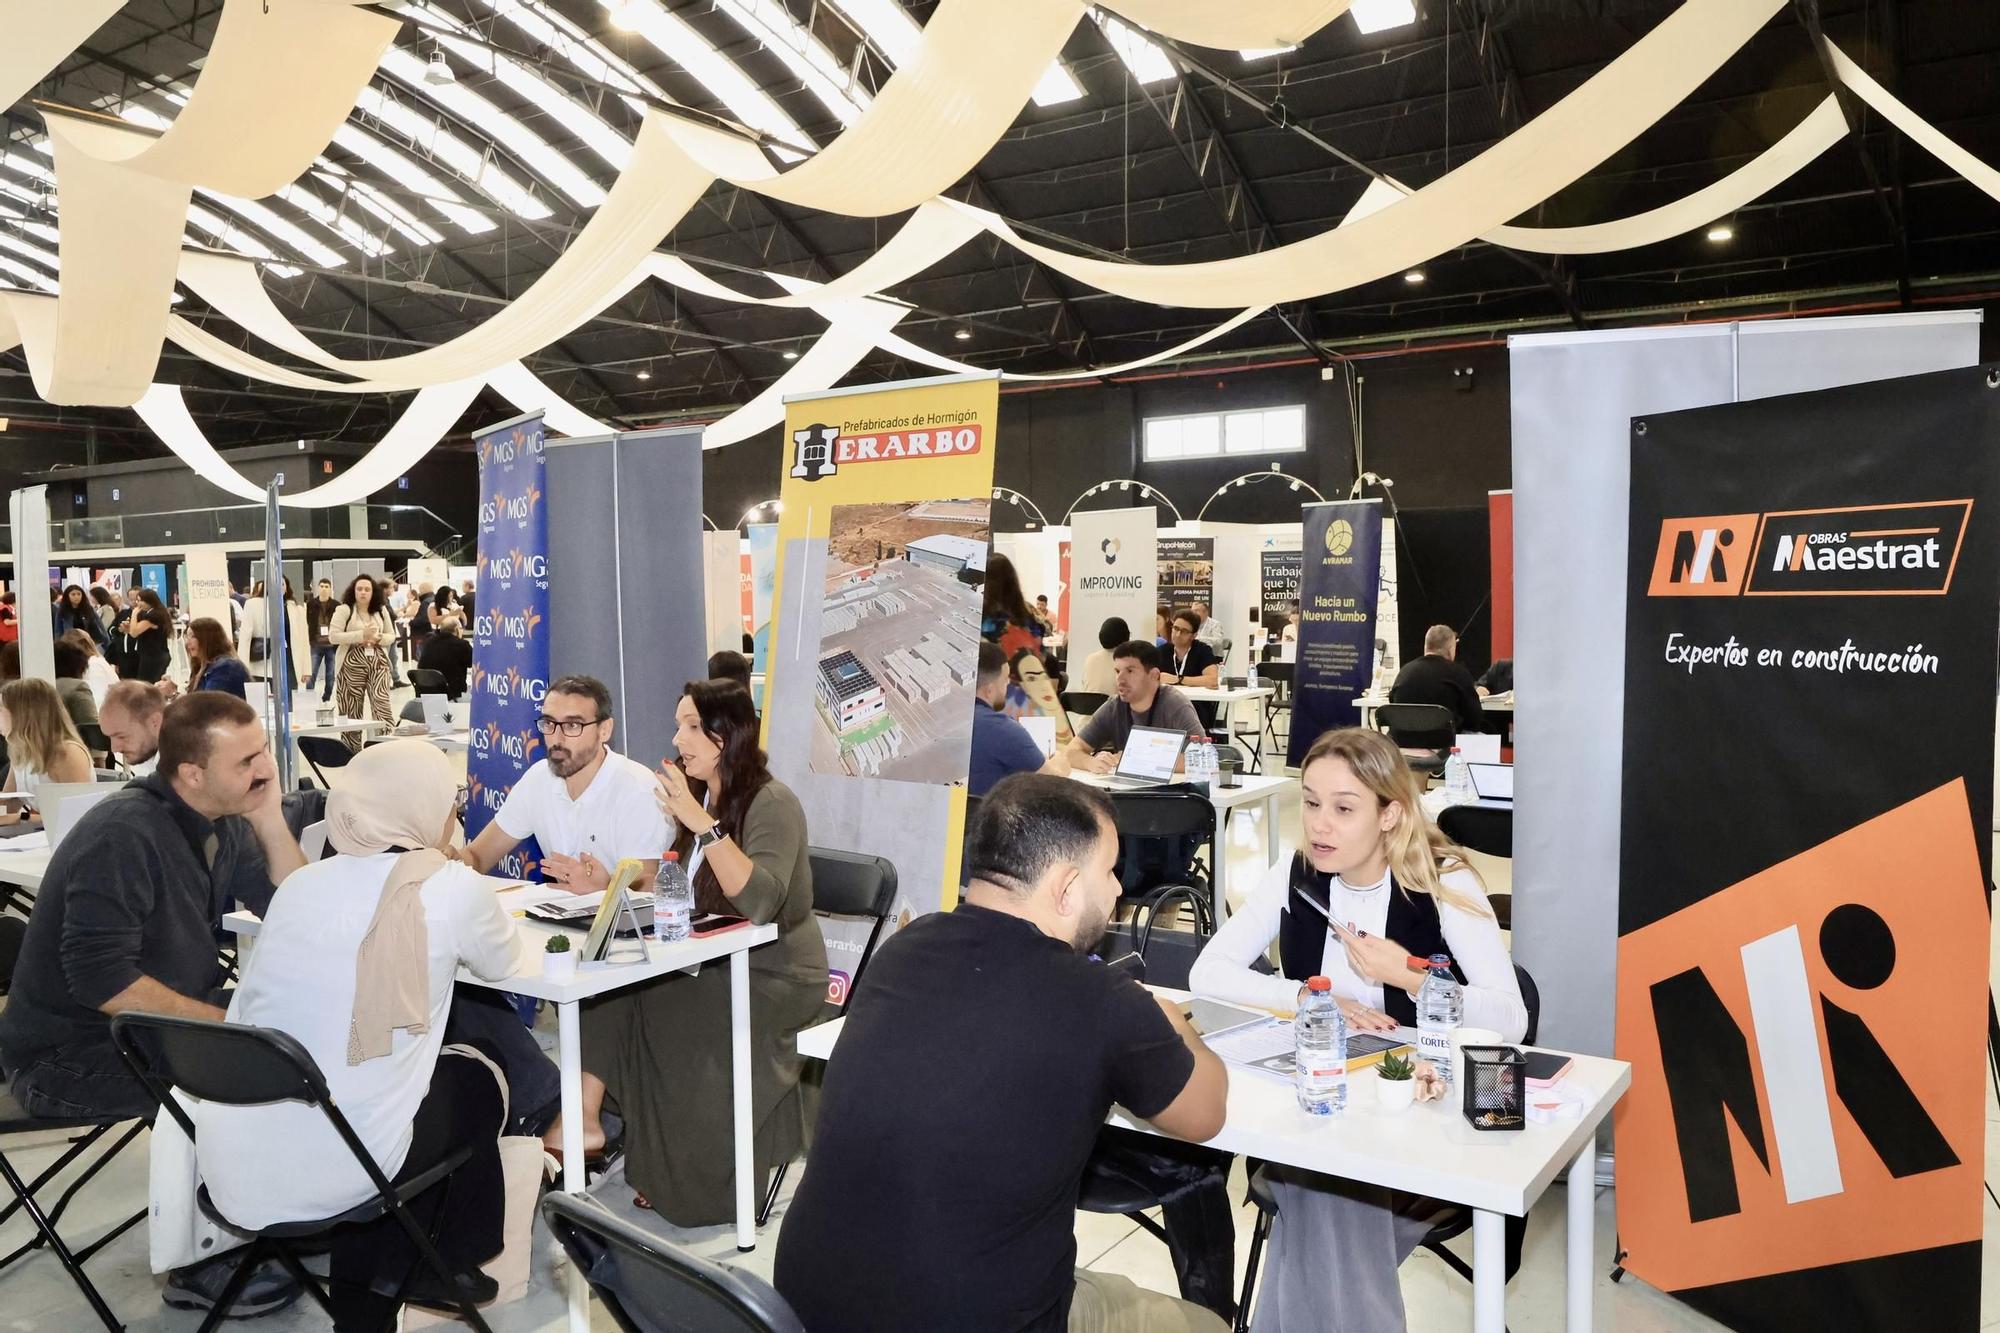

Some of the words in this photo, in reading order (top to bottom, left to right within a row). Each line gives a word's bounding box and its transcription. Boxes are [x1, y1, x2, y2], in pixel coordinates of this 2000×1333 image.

[843, 415, 909, 432] Prefabricados
[912, 414, 925, 427] de
[927, 409, 978, 426] Hormigón
[494, 440, 514, 464] MGS
[508, 496, 527, 519] MGS
[1808, 532, 1848, 545] OBRAS
[1323, 557, 1352, 565] AVRAMAR
[1772, 535, 1940, 572] Maestrat
[490, 558, 511, 579] MGS
[524, 556, 548, 577] MG
[1080, 576, 1142, 590] IMPROVING
[1264, 580, 1283, 590] que
[1287, 578, 1297, 588] lo
[1264, 602, 1285, 611] todo
[1315, 596, 1340, 607] Hacia
[1343, 599, 1355, 608] un
[505, 617, 525, 638] MGS
[1303, 610, 1331, 621] Nuevo
[1333, 611, 1367, 623] Rumbo
[1665, 633, 1749, 674] Expertos
[1757, 648, 1782, 667] en
[1791, 639, 1939, 674] construcción
[487, 673, 508, 696] MGS
[502, 734, 522, 759] MGS
[499, 854, 520, 879] MGS
[824, 938, 864, 954] erarbo
